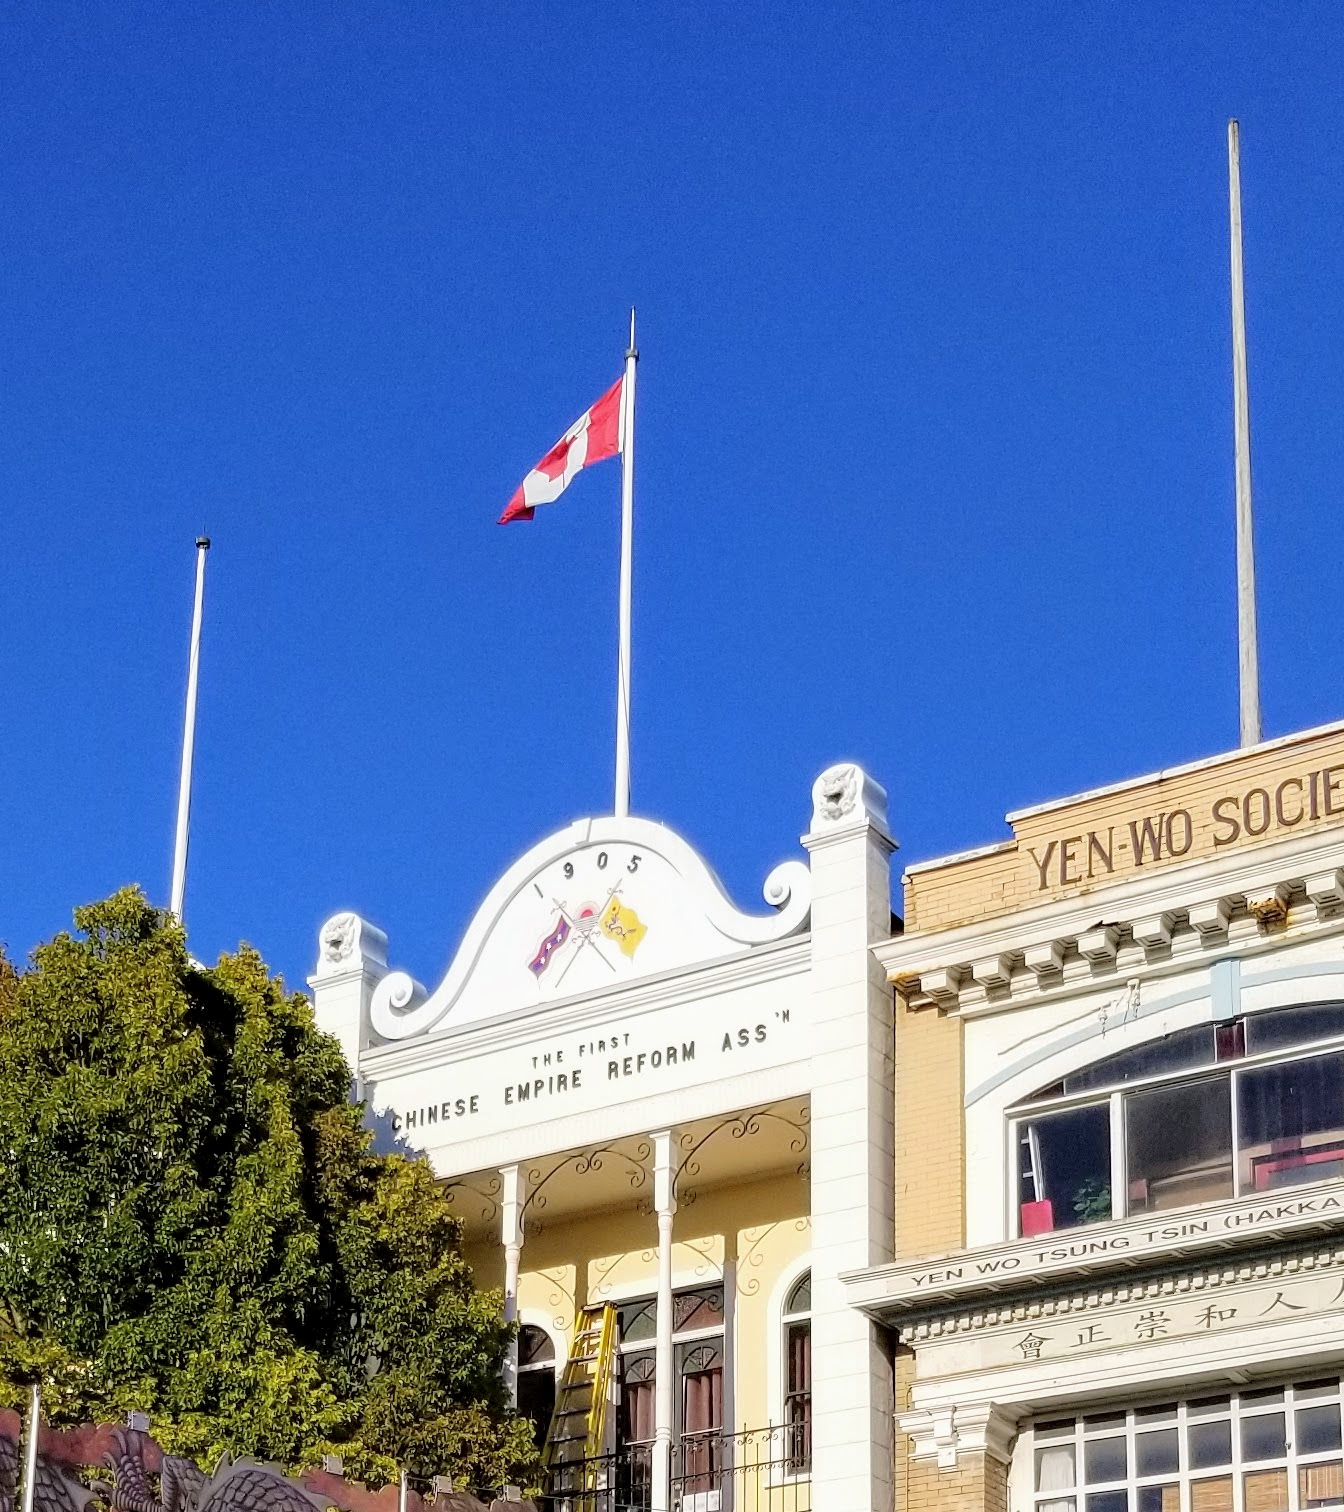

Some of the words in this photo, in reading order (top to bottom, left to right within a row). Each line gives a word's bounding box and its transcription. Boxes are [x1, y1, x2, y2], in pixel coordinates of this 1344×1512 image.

[1027, 808, 1193, 891] YEN-WO
[391, 1094, 480, 1132] CHINESE
[504, 1069, 583, 1106] EMPIRE
[607, 1040, 696, 1081] REFORM
[531, 1050, 564, 1070] THE
[579, 1033, 630, 1058] FIRST
[911, 1267, 964, 1288] YEN
[975, 1257, 1022, 1275] WO
[1032, 1236, 1131, 1264] TSUNG
[1140, 1220, 1209, 1244] TSIN
